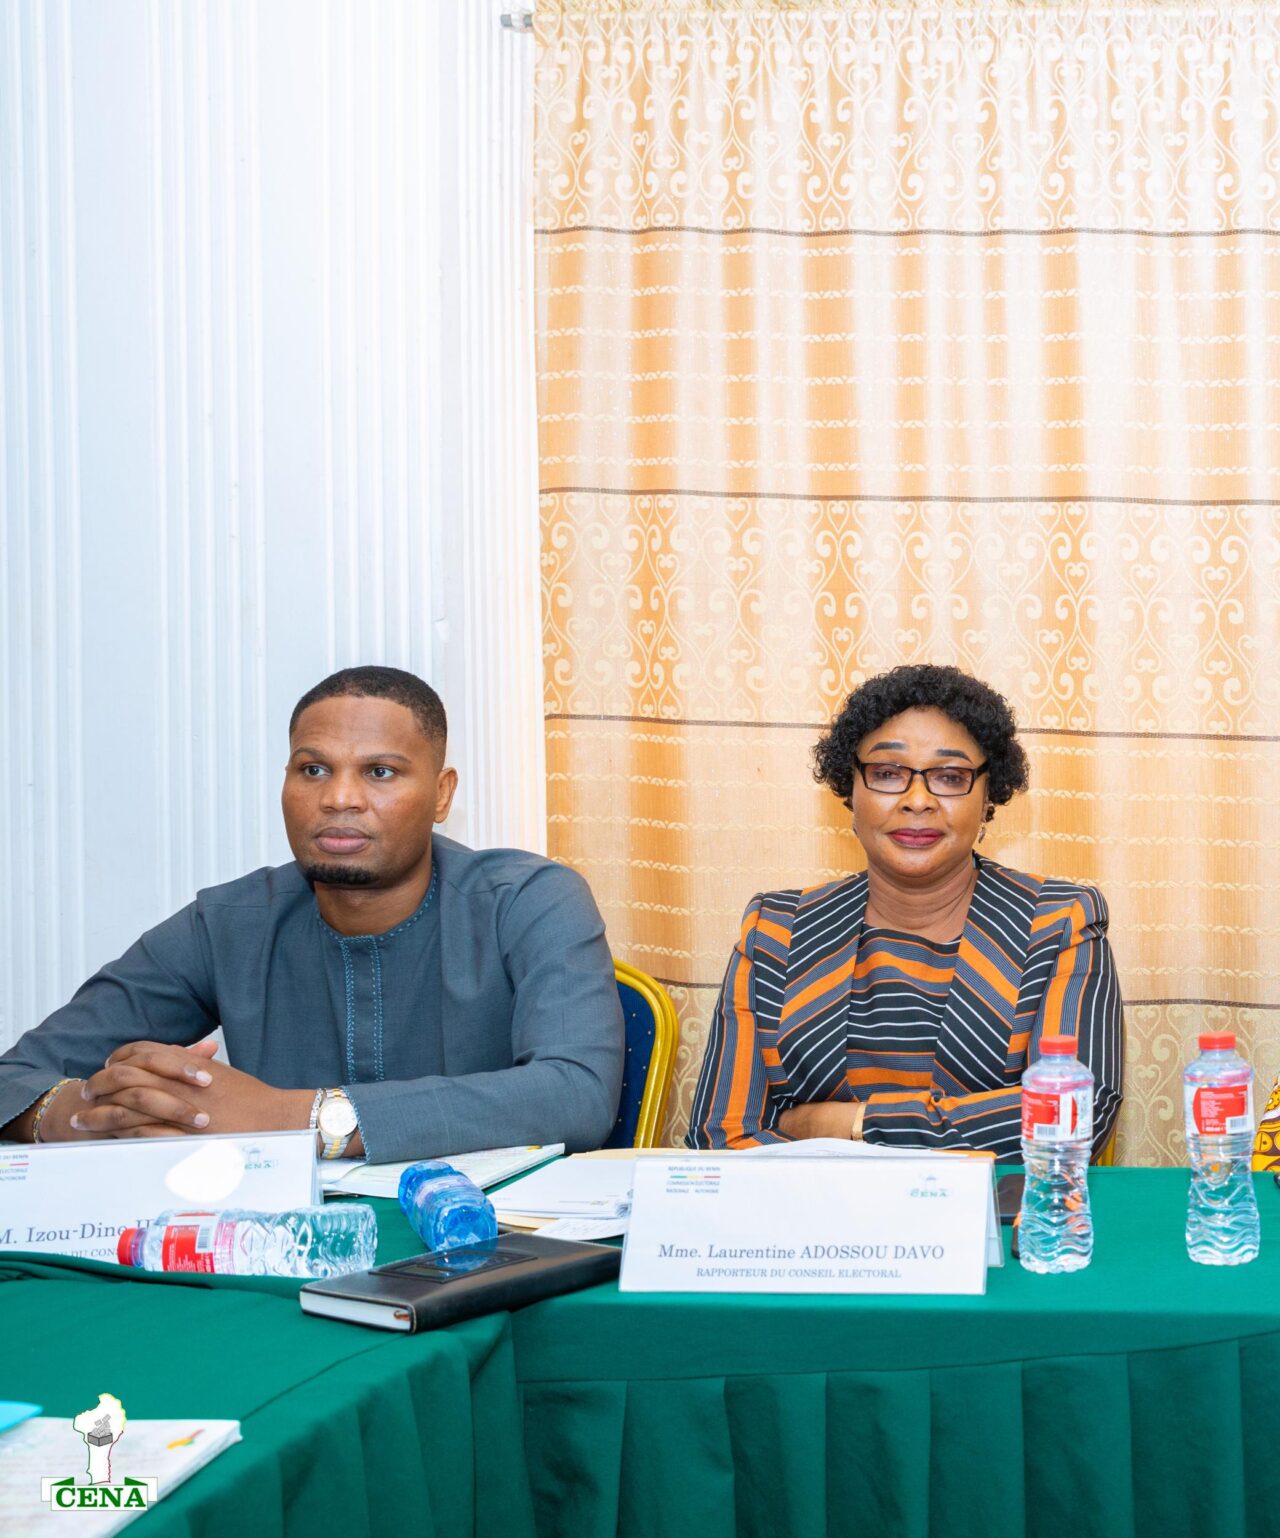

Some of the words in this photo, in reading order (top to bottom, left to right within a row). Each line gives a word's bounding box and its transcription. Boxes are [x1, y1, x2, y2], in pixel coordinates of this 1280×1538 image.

[658, 1244, 702, 1258] Mme.
[708, 1244, 796, 1259] Laurentine
[800, 1245, 888, 1260] ADOSSOU
[894, 1245, 944, 1260] DAVO
[697, 1267, 767, 1277] RAPPORTEUR
[770, 1268, 785, 1278] DU
[788, 1268, 835, 1278] CONSEIL
[838, 1269, 901, 1278] ELECTORAL
